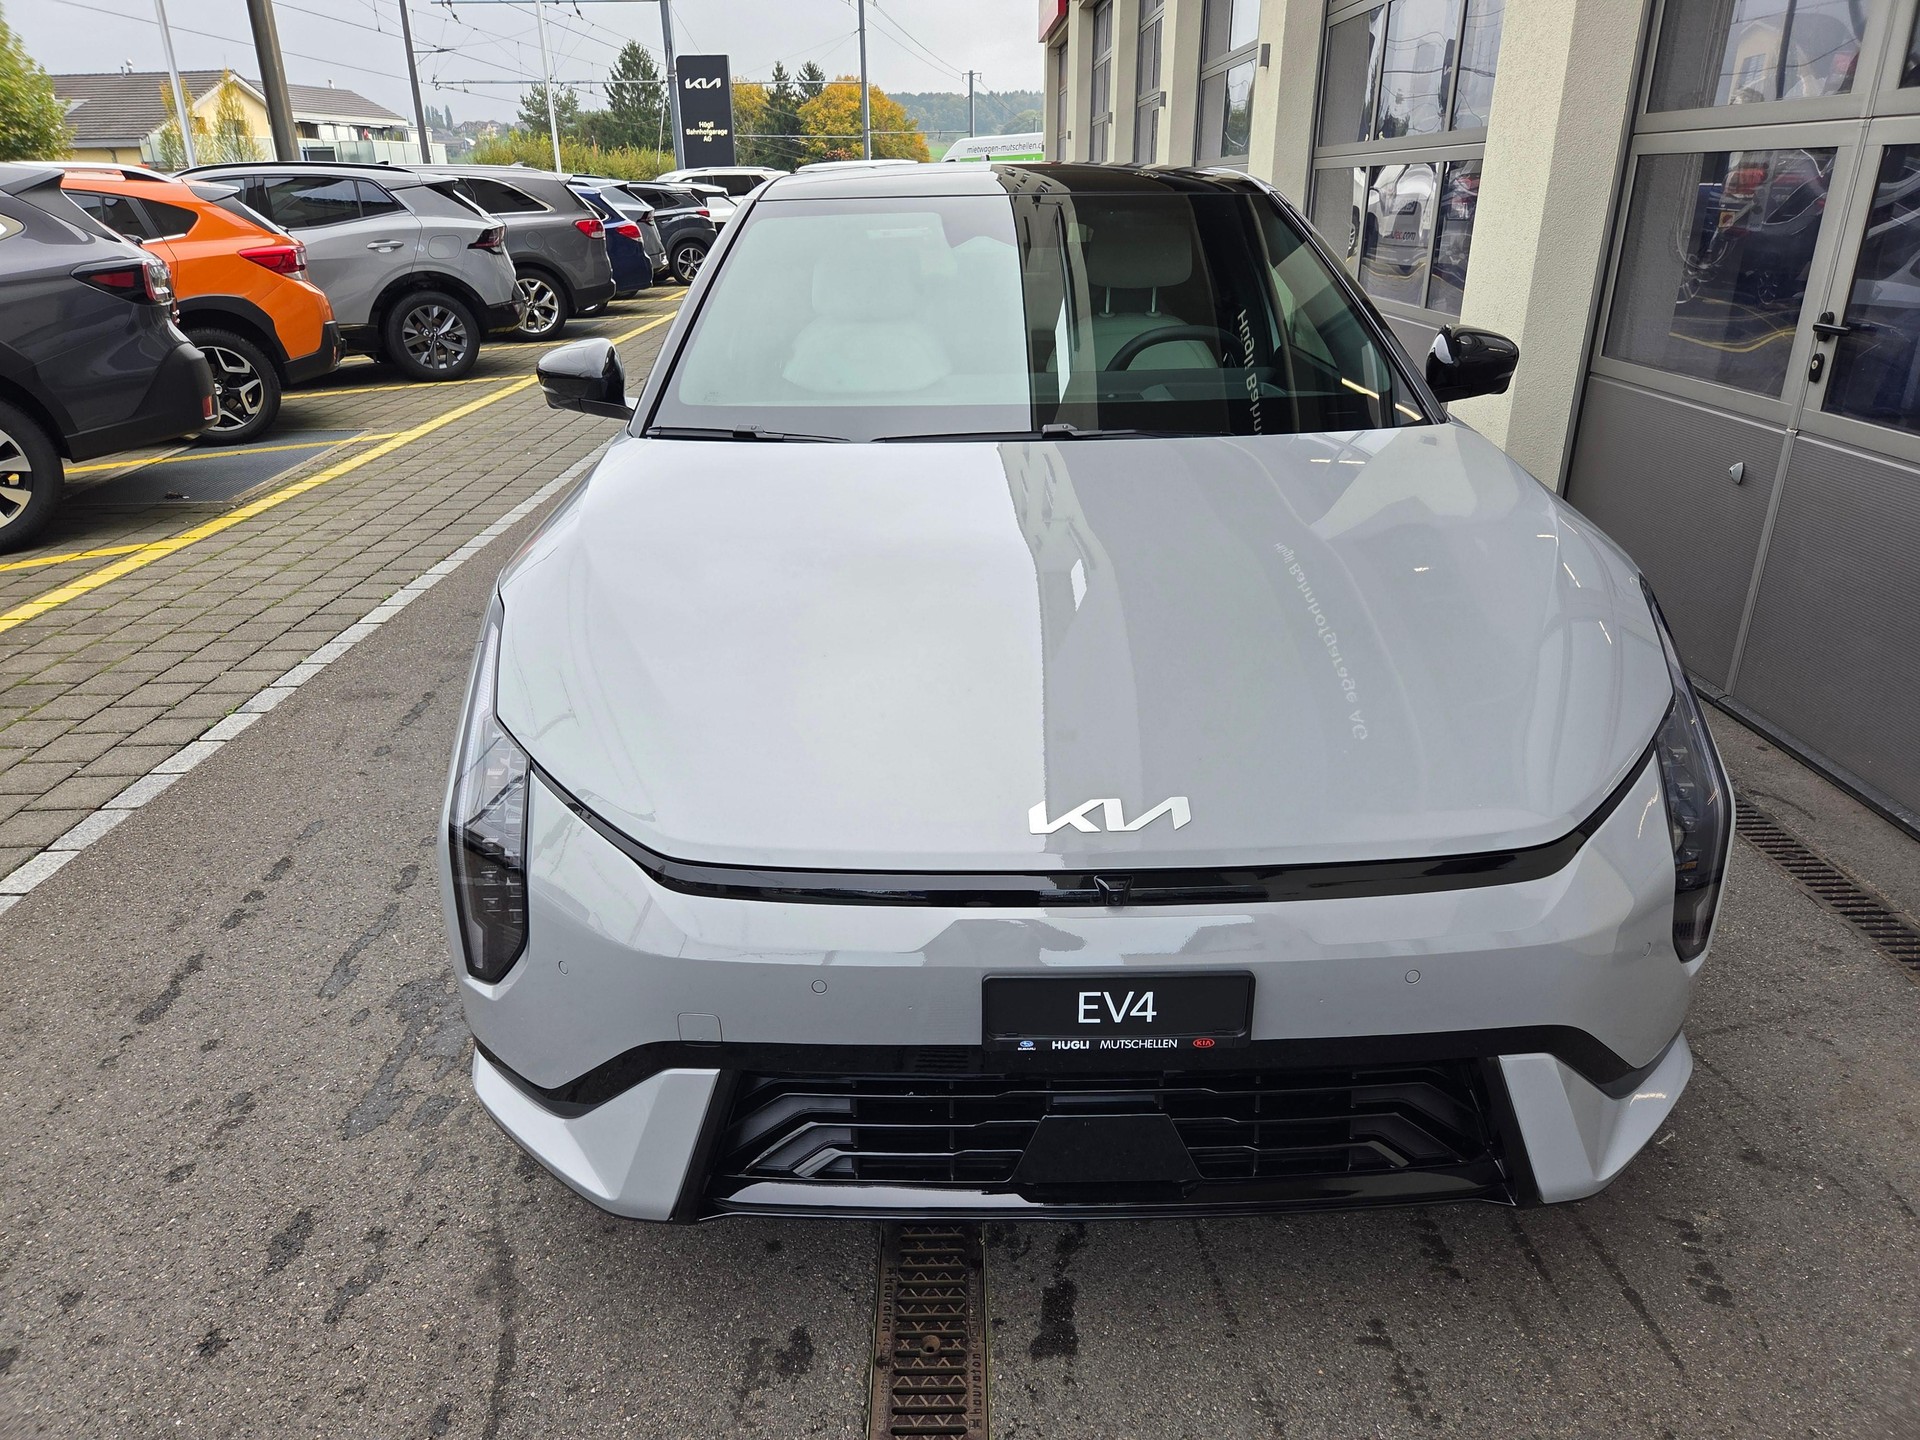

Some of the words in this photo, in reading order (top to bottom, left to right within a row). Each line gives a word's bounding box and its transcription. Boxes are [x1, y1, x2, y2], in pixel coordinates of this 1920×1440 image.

[685, 78, 721, 89] KIA
[1028, 796, 1191, 835] KIA
[1078, 991, 1157, 1024] EV4
[1100, 1039, 1178, 1049] MUTSCHELLEN
[1195, 1039, 1212, 1047] KIA
